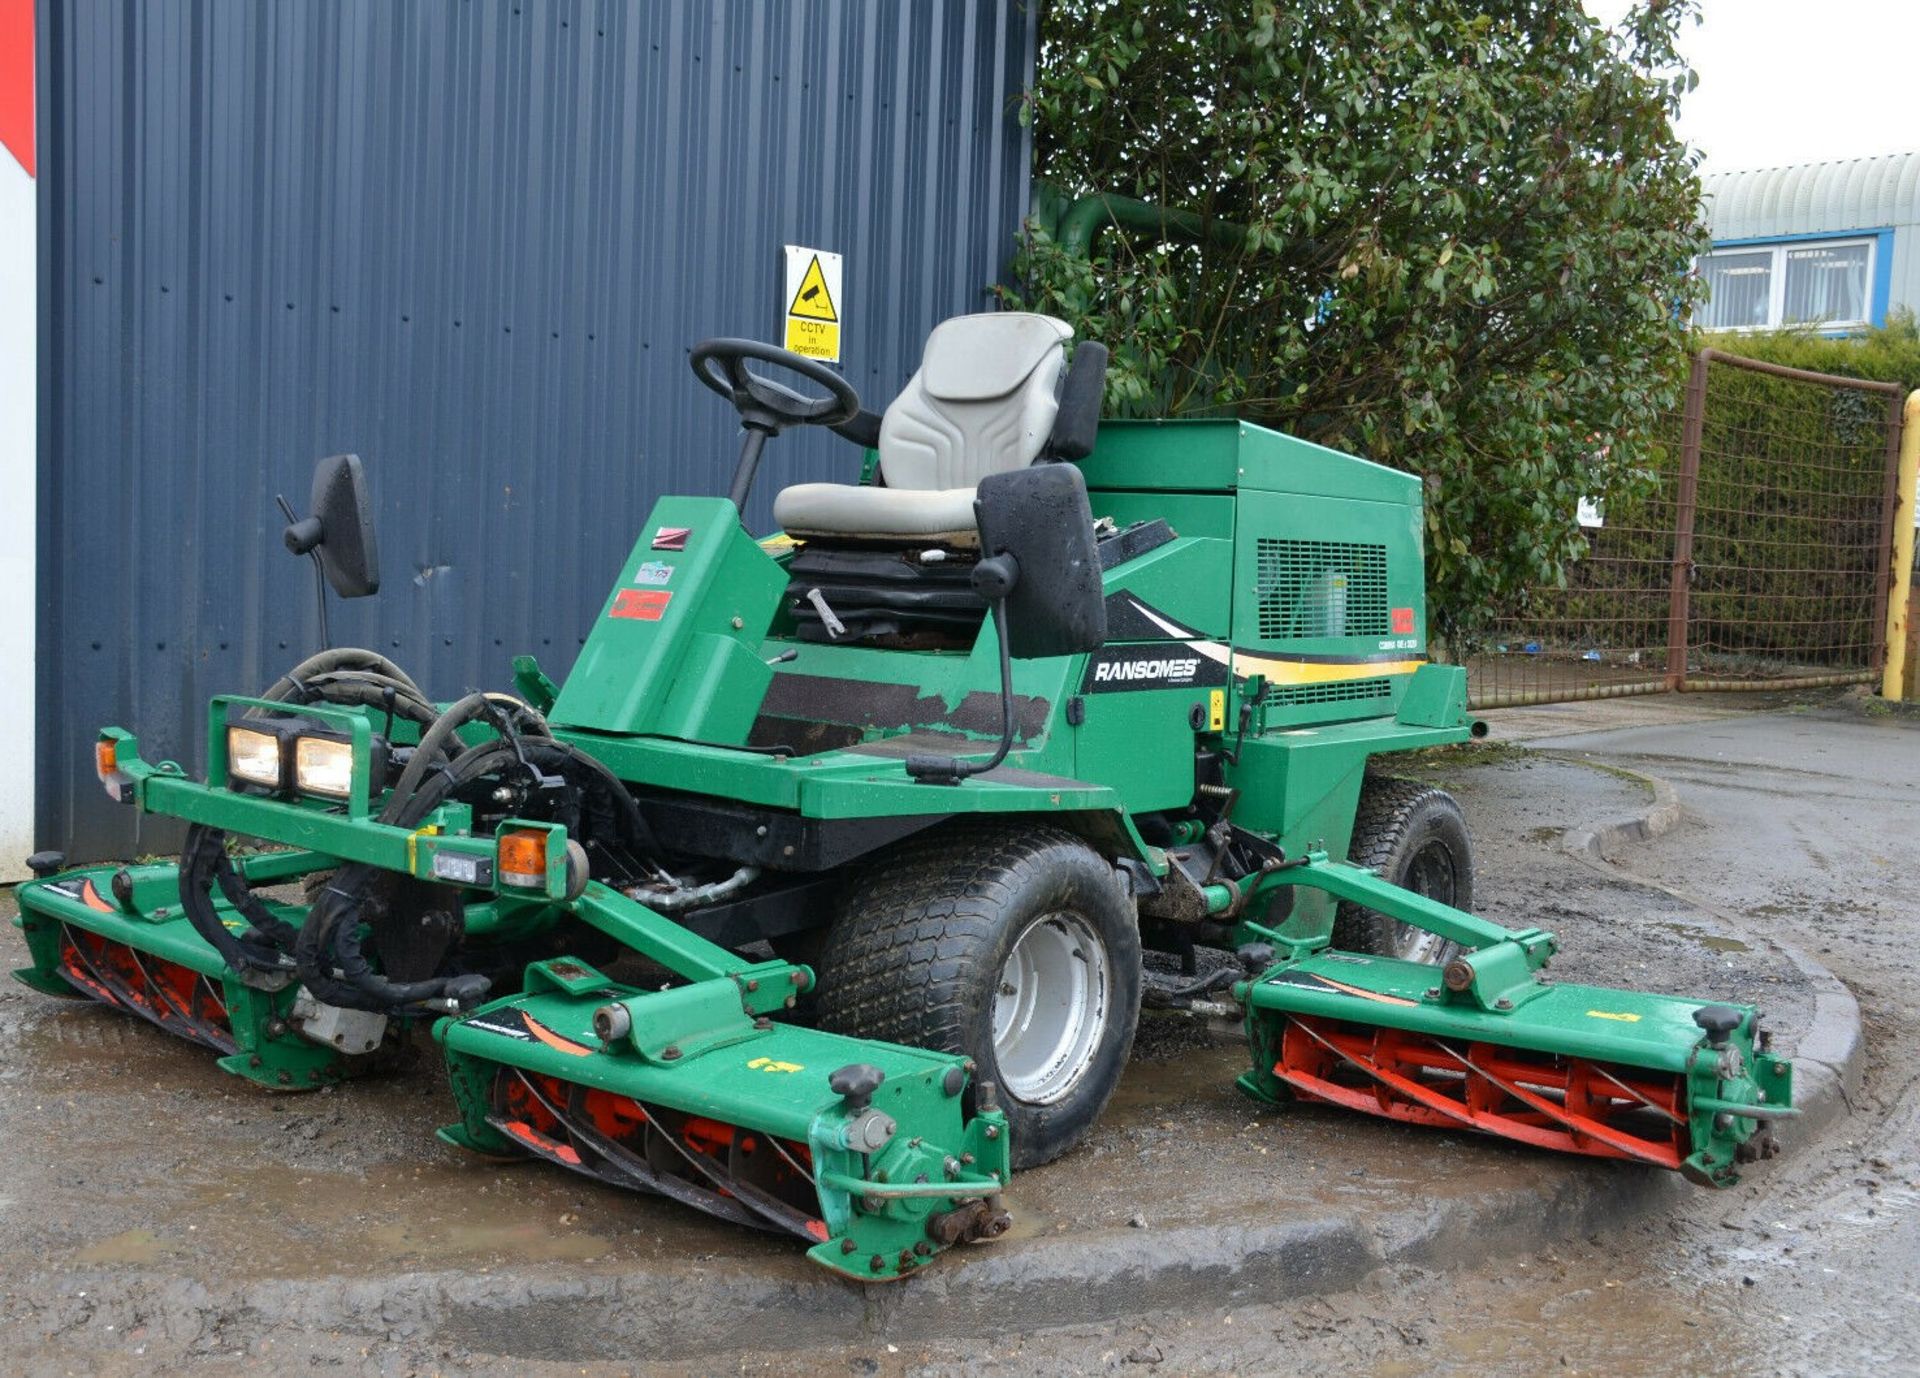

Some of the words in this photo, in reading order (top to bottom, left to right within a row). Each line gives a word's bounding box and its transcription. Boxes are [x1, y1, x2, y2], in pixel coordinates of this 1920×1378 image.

[800, 321, 826, 334] CCTV
[808, 335, 817, 345] in
[793, 344, 831, 356] operation
[1095, 659, 1197, 681] RANSOMES
